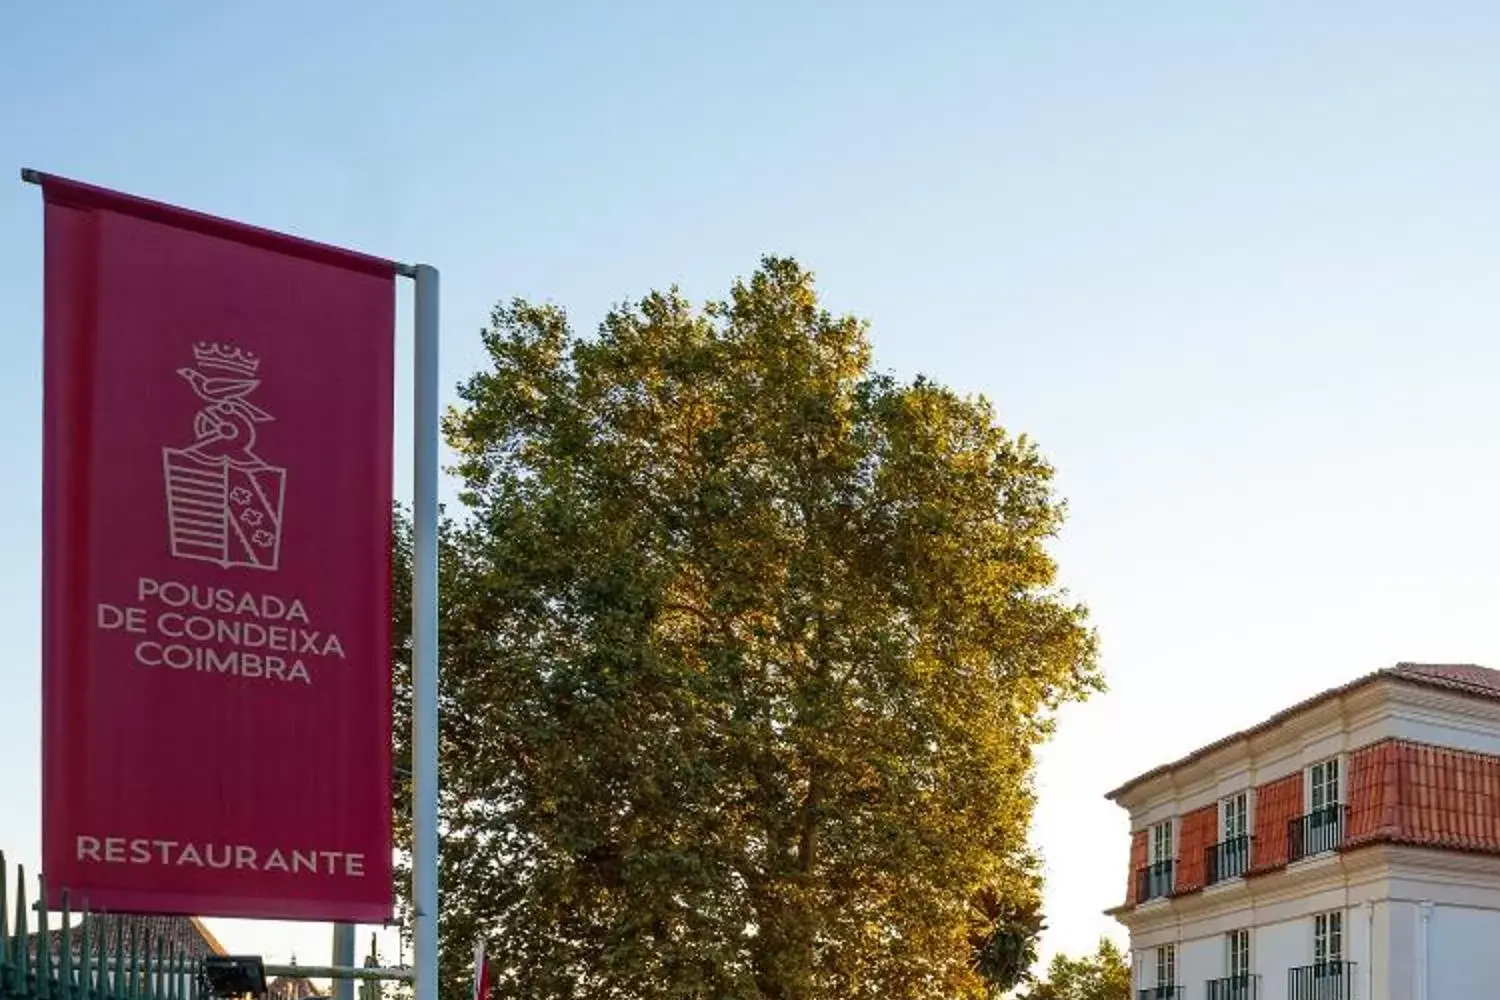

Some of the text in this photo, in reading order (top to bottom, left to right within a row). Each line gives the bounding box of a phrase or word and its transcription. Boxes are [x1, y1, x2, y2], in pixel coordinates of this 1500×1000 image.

[138, 578, 310, 623] POUSADA
[97, 604, 346, 658] DE CONDEIXA
[135, 641, 311, 684] COIMBRA
[76, 835, 365, 877] RESTAURANTE
